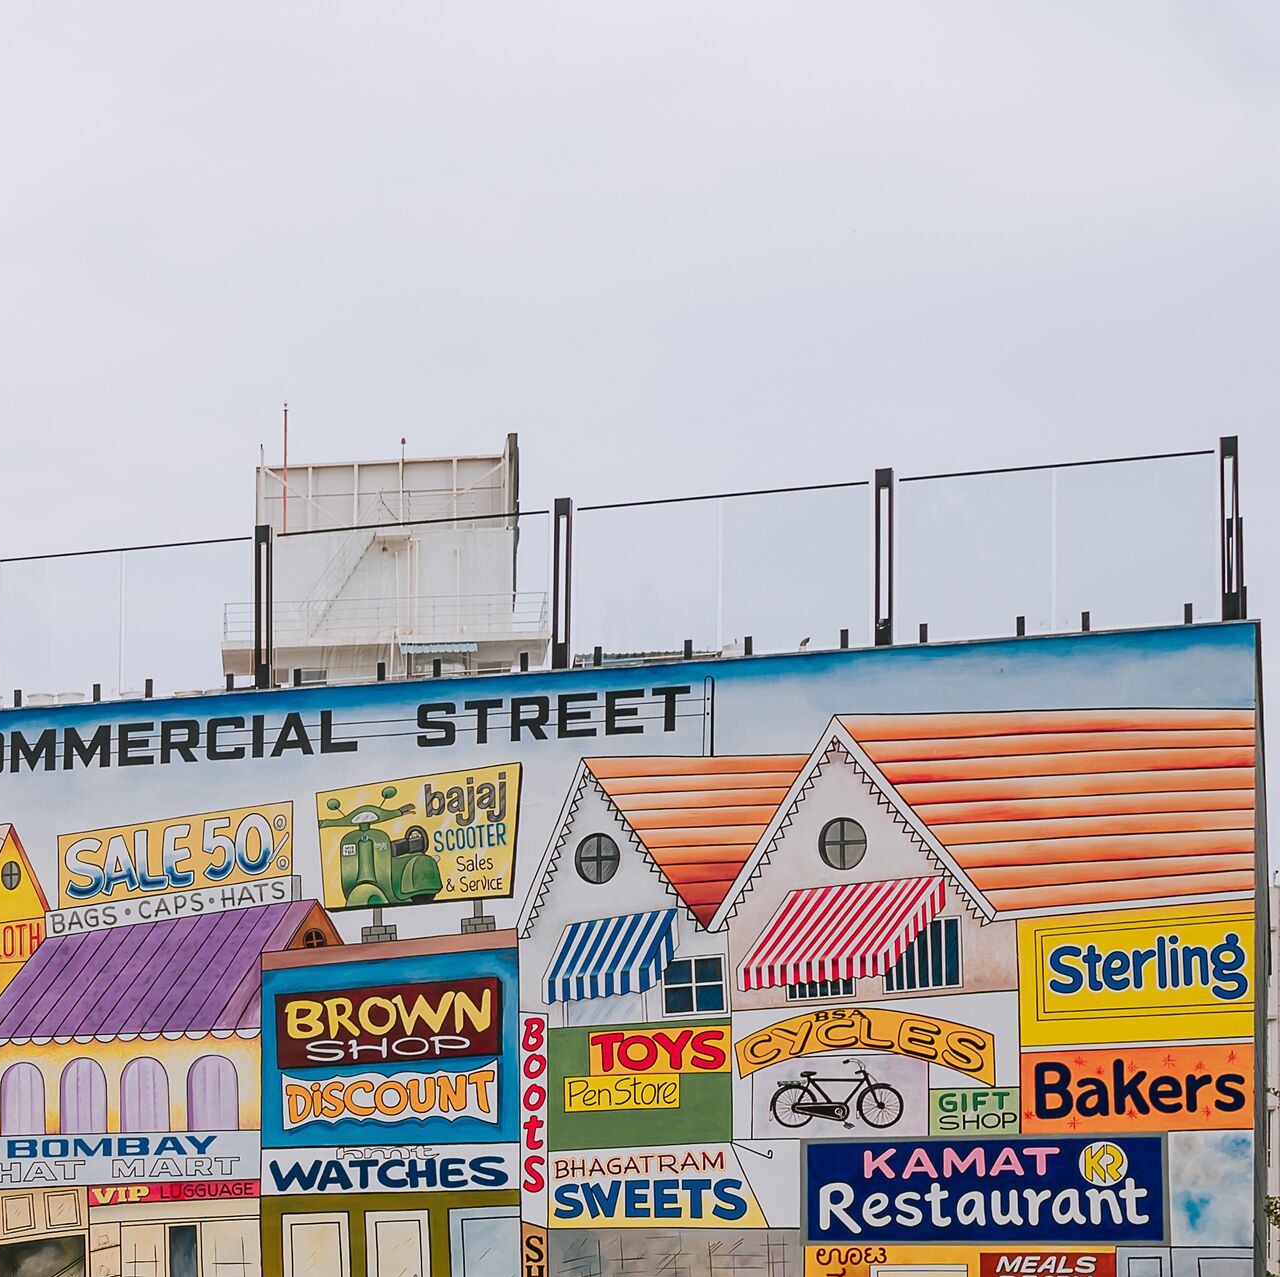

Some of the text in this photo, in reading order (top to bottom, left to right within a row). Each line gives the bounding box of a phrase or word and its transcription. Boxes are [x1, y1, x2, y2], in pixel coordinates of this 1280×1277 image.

[416, 685, 692, 749] STREET
[424, 771, 507, 826] bajaj
[433, 822, 508, 853] SCOOTER
[64, 812, 290, 900] SALE 50%
[456, 853, 494, 872] Sales
[446, 878, 456, 893] &
[50, 880, 286, 934] BAGS CAPS HATS
[1048, 932, 1250, 1000] Sterling
[284, 988, 492, 1040] BROWN
[814, 1009, 868, 1023] BSA
[306, 1034, 471, 1063] SHOP
[590, 1029, 726, 1073] TOYS
[743, 1017, 987, 1072] CYCLES
[567, 1076, 678, 1108] Pen Store
[938, 1091, 1012, 1113] GIFT
[1034, 1057, 1247, 1120] Bakers
[939, 1111, 1019, 1132] SHOP
[7, 1135, 218, 1159] BOMBAY
[335, 1144, 441, 1160] hmt
[862, 1146, 1061, 1180] KAMAT
[112, 1156, 241, 1179] MART
[268, 1155, 509, 1192] WATCHES
[553, 1150, 726, 1180] BHAGATRAM
[91, 1181, 255, 1204] VIP LUGGUAGE
[553, 1178, 748, 1221] SWEETS
[818, 1177, 1151, 1235] Restaurant
[995, 1254, 1097, 1274] MEALS
